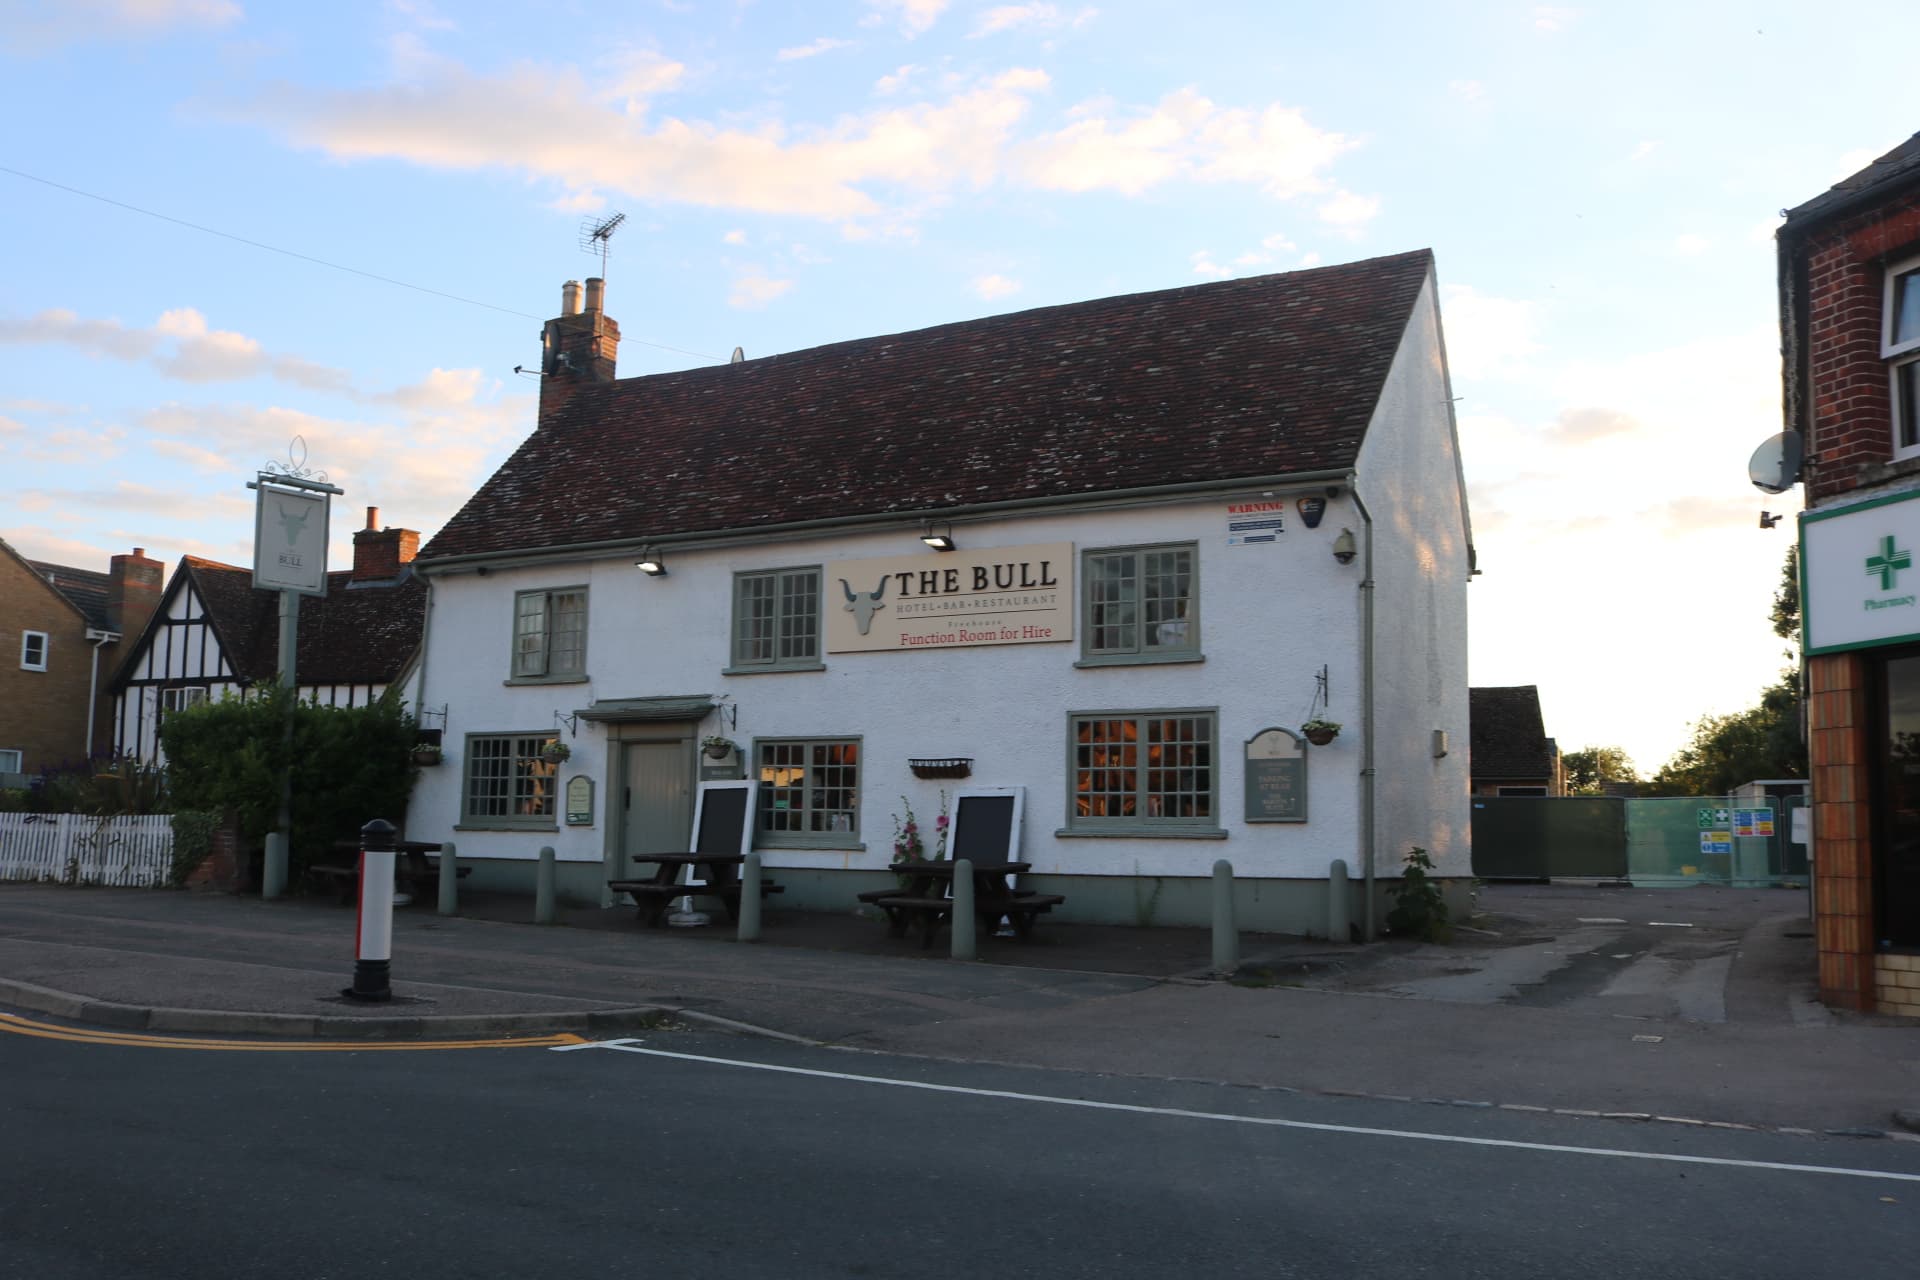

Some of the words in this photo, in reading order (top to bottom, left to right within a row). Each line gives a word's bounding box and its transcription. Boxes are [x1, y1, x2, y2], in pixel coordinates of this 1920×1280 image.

[1228, 502, 1283, 513] WARNING
[279, 555, 303, 567] BULL
[895, 569, 959, 596] THE
[971, 561, 1057, 591] BULL
[1864, 596, 1916, 611] Pharmacy
[899, 632, 955, 646] Function
[959, 629, 996, 642] Room
[1000, 626, 1019, 639] for
[1022, 625, 1052, 639] Hire
